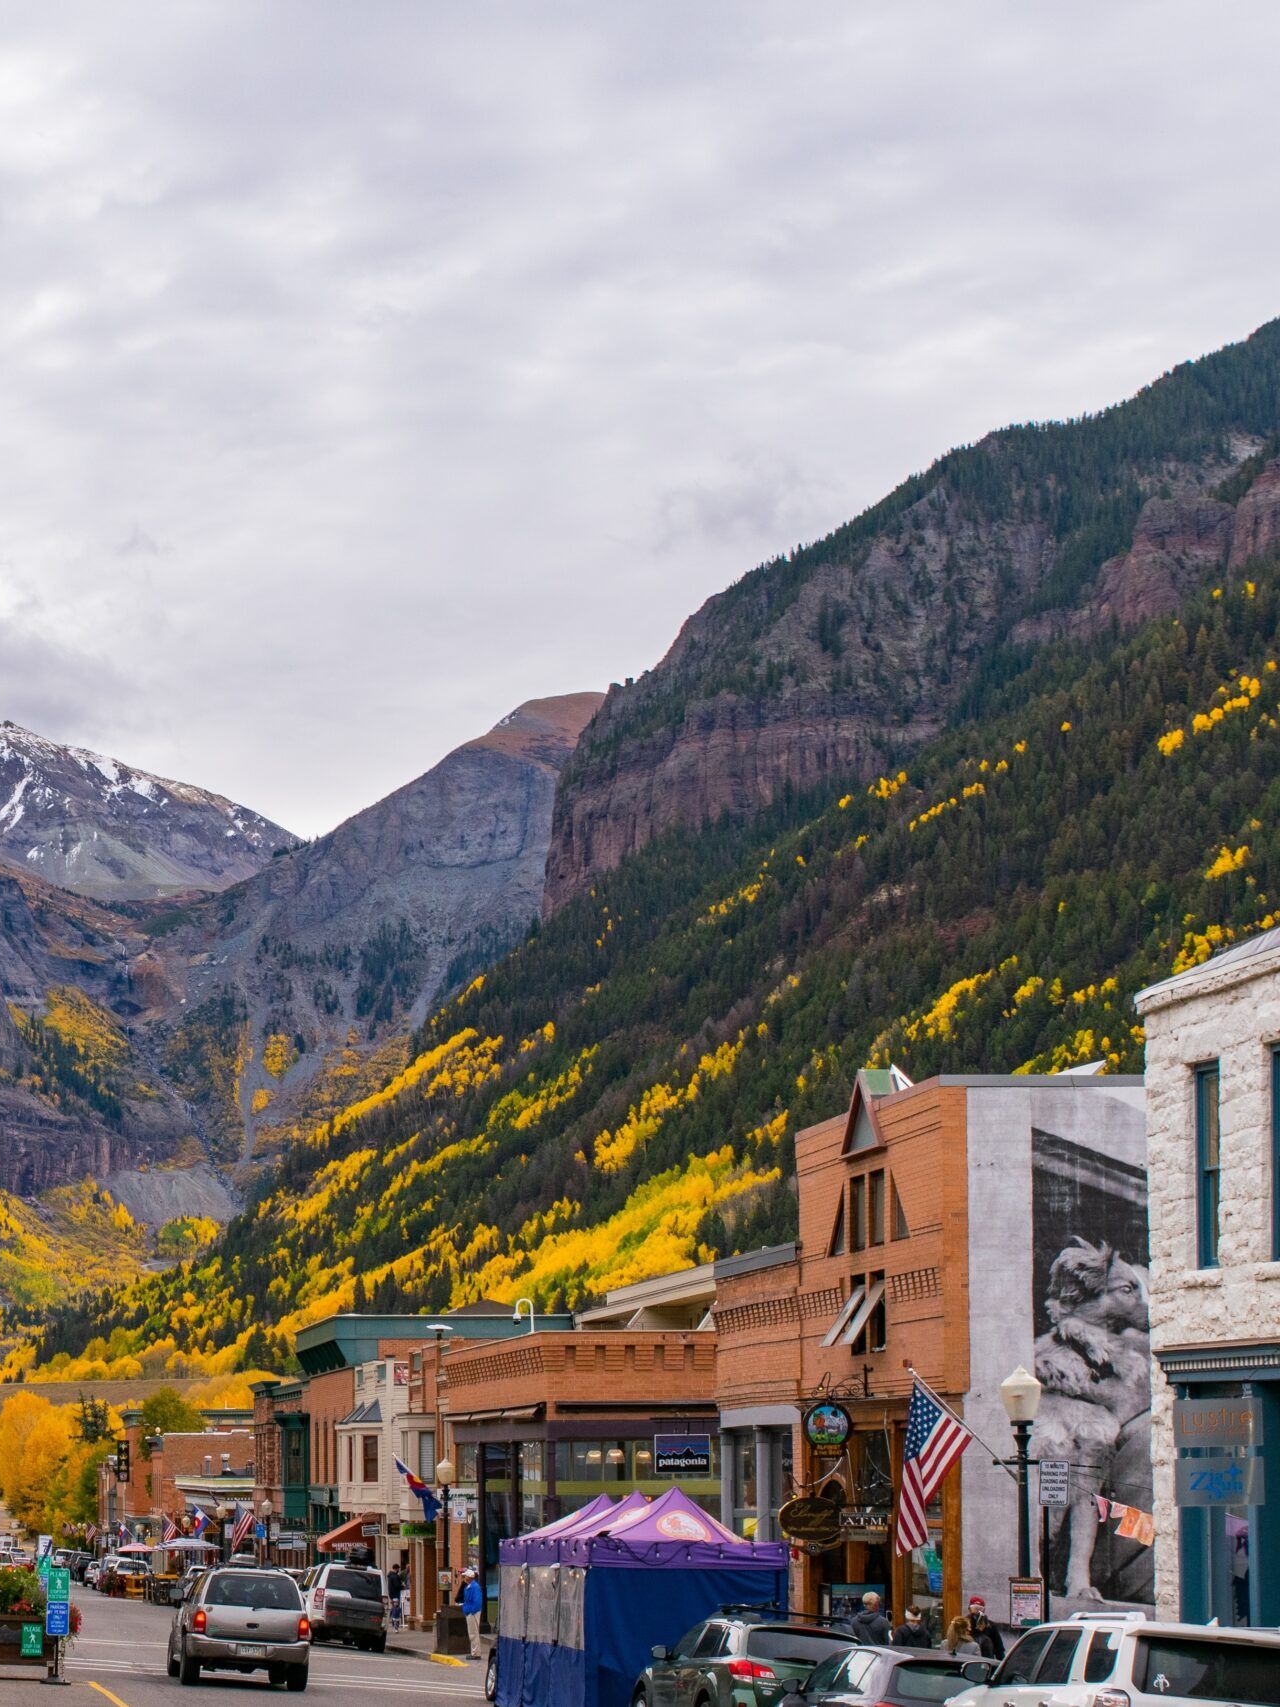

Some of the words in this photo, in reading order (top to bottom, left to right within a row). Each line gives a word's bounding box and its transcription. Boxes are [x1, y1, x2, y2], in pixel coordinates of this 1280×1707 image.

[1181, 1408, 1253, 1435] Lustre
[659, 1457, 707, 1467] patagonia
[843, 1517, 885, 1526] A.T.M.
